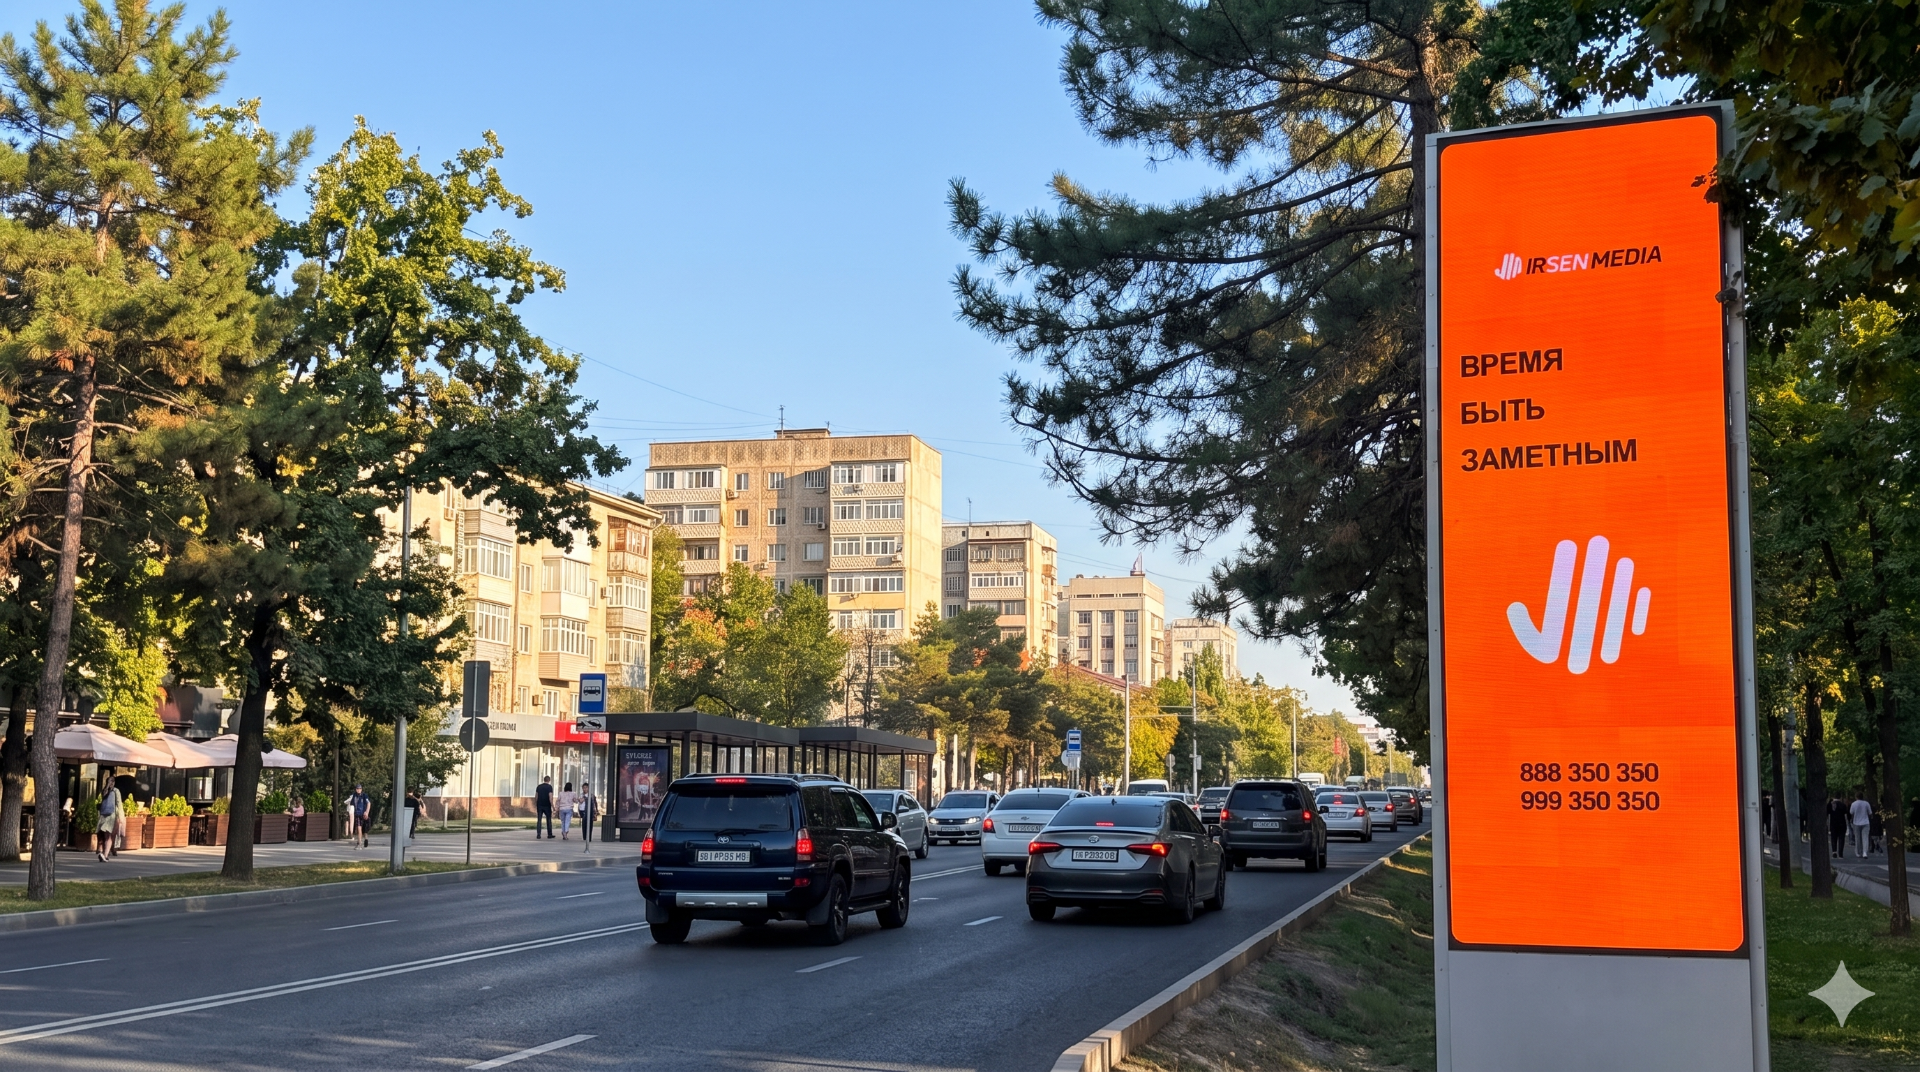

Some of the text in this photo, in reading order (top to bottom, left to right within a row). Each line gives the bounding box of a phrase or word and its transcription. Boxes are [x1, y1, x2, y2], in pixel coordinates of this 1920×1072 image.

[1526, 245, 1662, 275] IRSEN MEDIA
[1460, 348, 1563, 378] ВРЕМЯ
[1460, 398, 1545, 425] БЫТЬ
[1460, 438, 1637, 472] ЗАМЕТНЫМ
[1520, 762, 1659, 782] 888 350 350
[1520, 791, 1660, 811] 999 350 350
